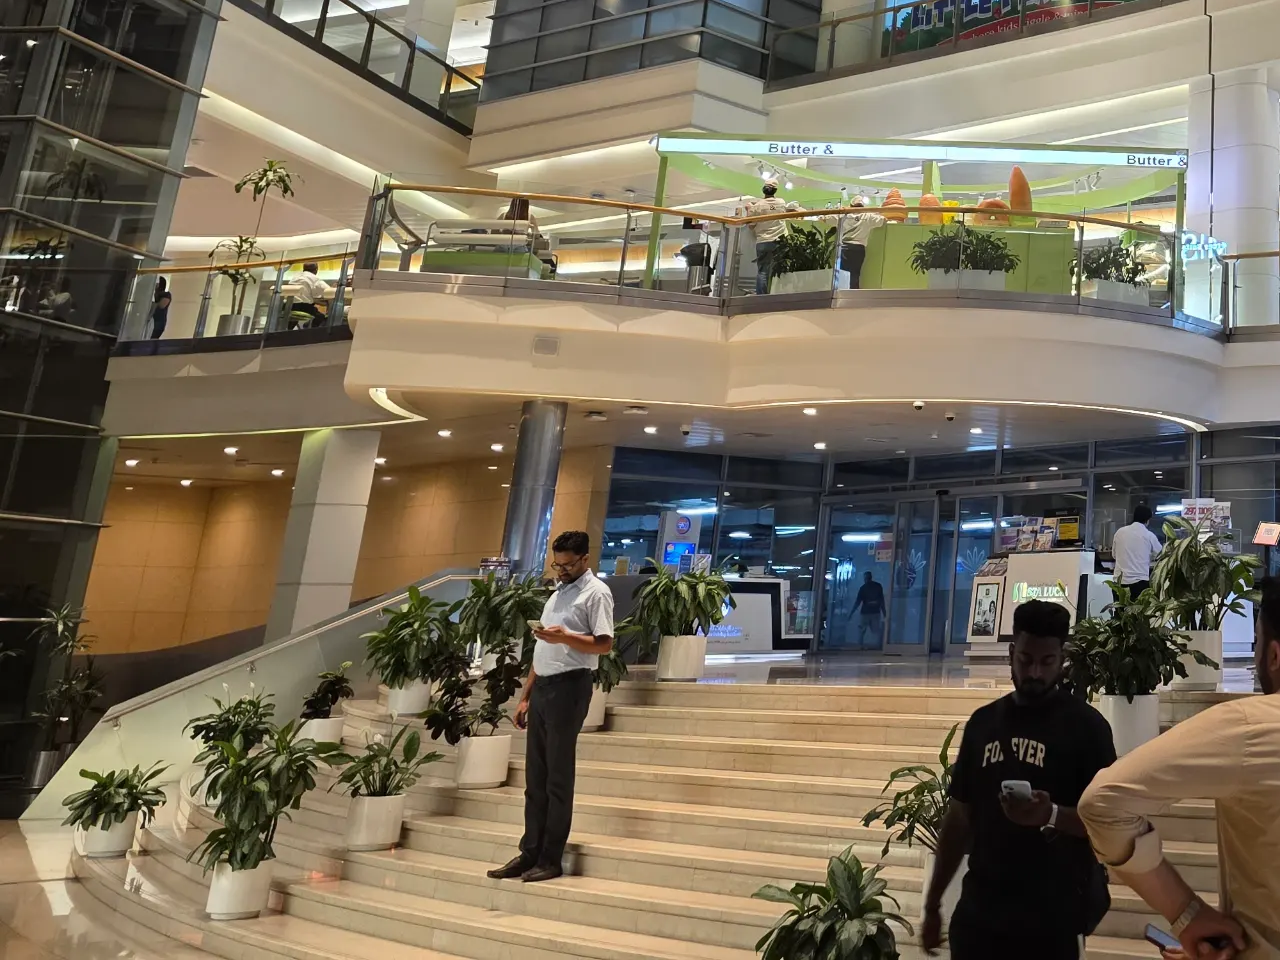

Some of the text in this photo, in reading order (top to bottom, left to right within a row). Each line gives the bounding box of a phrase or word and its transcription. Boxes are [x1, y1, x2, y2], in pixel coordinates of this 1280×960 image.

[768, 143, 834, 155] Butter &
[1127, 154, 1187, 167] Butter &
[982, 737, 1046, 768] FOEVER
